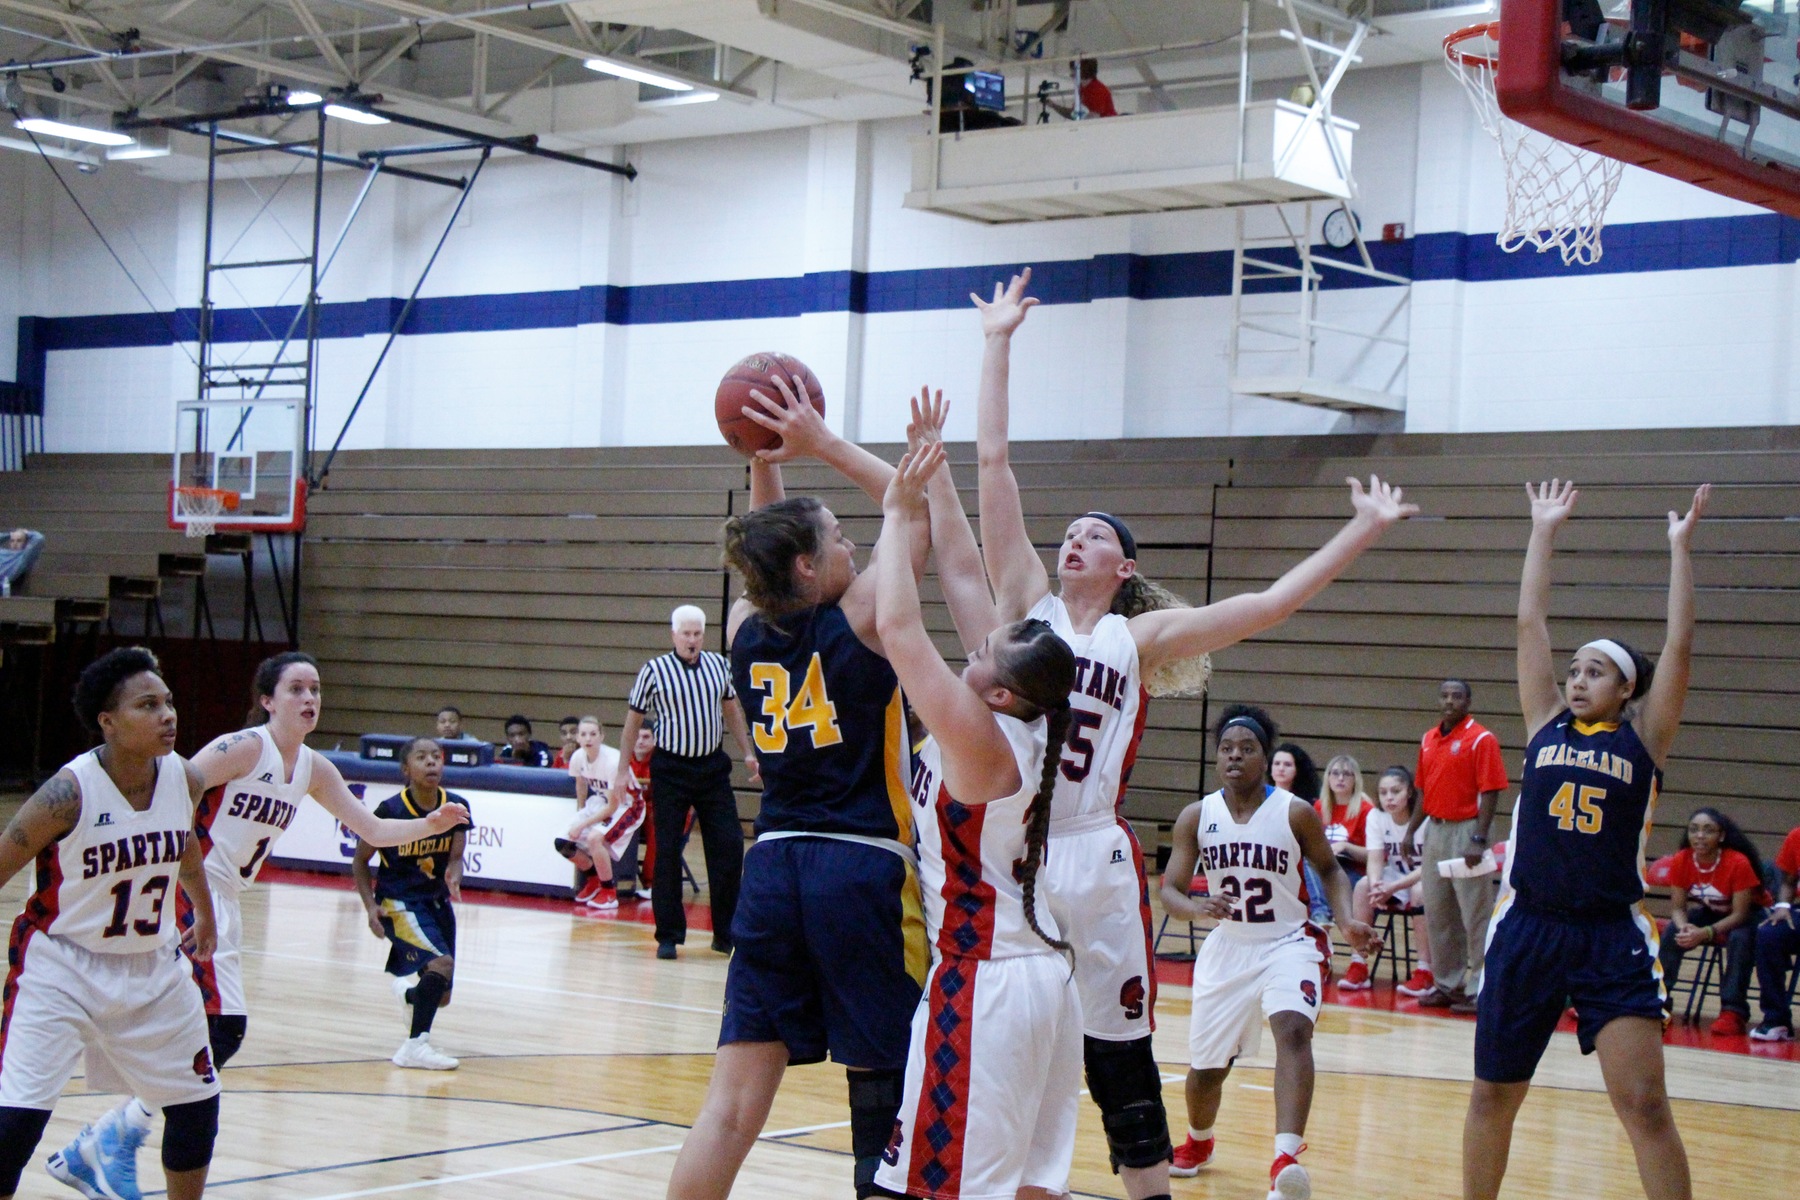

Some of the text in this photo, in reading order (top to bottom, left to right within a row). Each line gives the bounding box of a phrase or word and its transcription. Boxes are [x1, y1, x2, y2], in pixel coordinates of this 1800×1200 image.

[750, 652, 843, 753] 34
[1073, 656, 1127, 711] TANS
[1059, 707, 1103, 783] 5
[1535, 743, 1633, 785] GRACELAND
[227, 792, 297, 831] SPARTA
[1548, 781, 1607, 835] 45
[239, 836, 271, 878] 1
[398, 836, 452, 856] GRACELAN
[467, 825, 504, 848] ERN
[1202, 842, 1289, 876] SPARTANS
[102, 875, 170, 938] 13
[1220, 875, 1276, 923] 22
